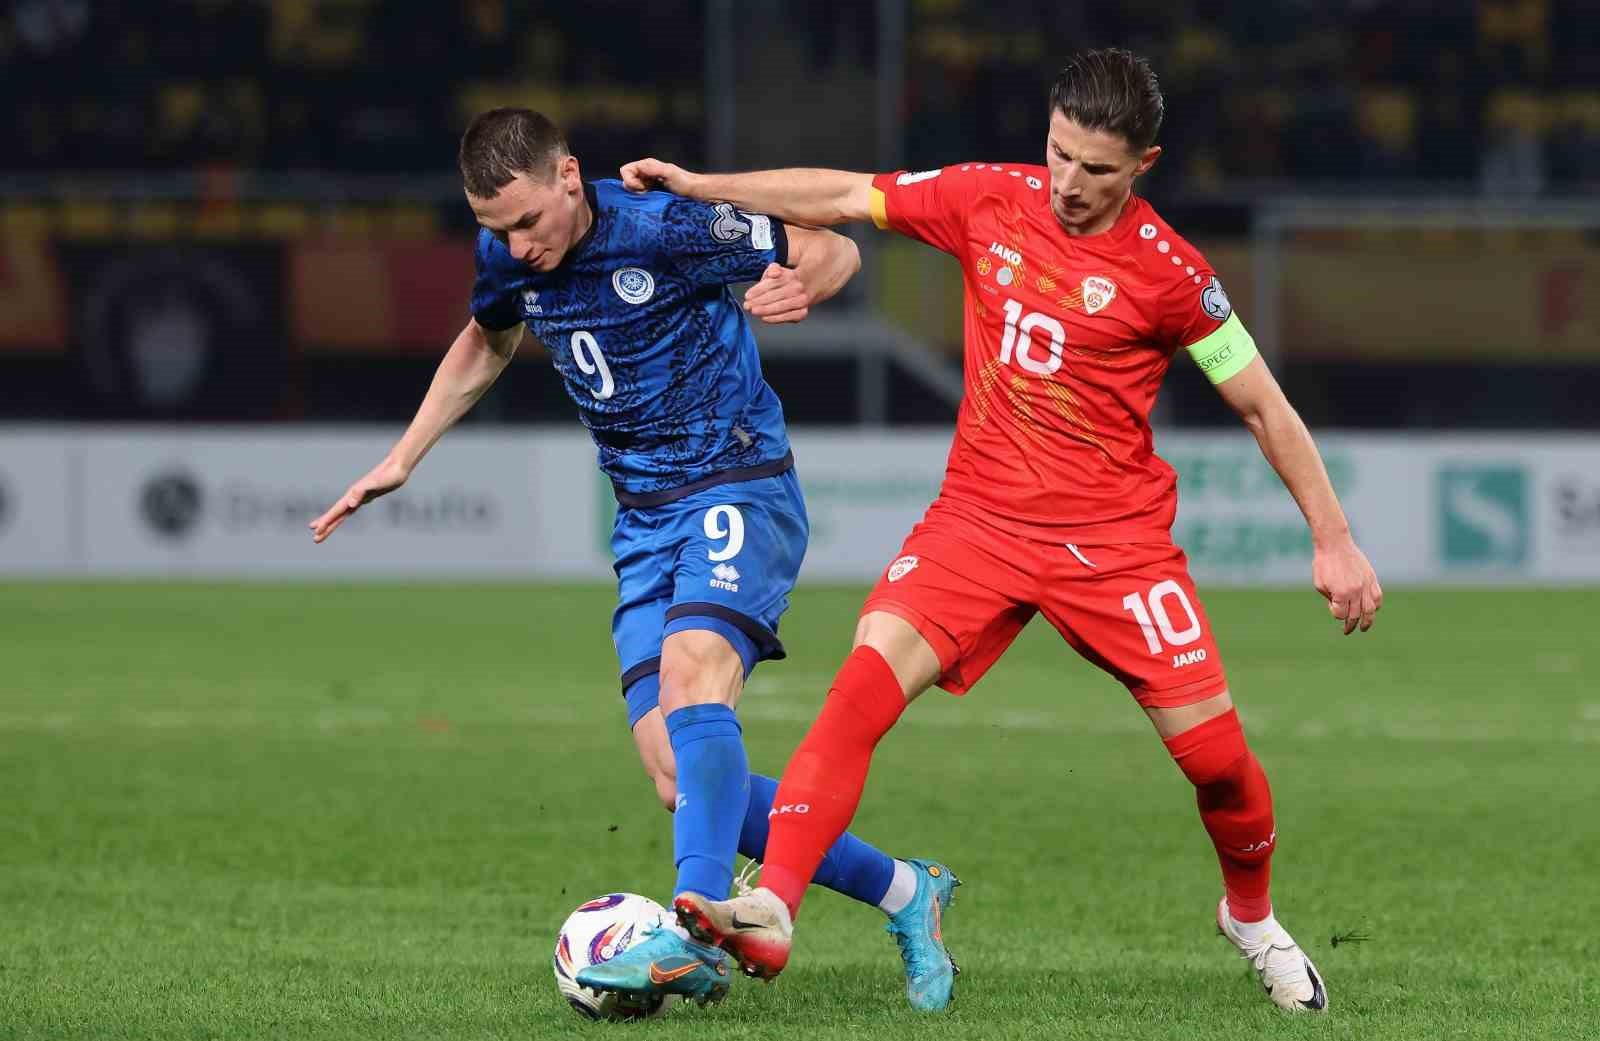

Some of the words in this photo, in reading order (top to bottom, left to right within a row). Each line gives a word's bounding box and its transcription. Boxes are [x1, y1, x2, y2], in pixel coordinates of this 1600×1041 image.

[988, 241, 1022, 266] JAKO
[1000, 298, 1067, 375] 10
[1198, 344, 1231, 370] SPECT
[570, 328, 615, 401] 9
[703, 504, 745, 562] 9
[1122, 579, 1201, 655] 10
[1172, 648, 1207, 669] JAKO
[768, 804, 810, 819] AKO
